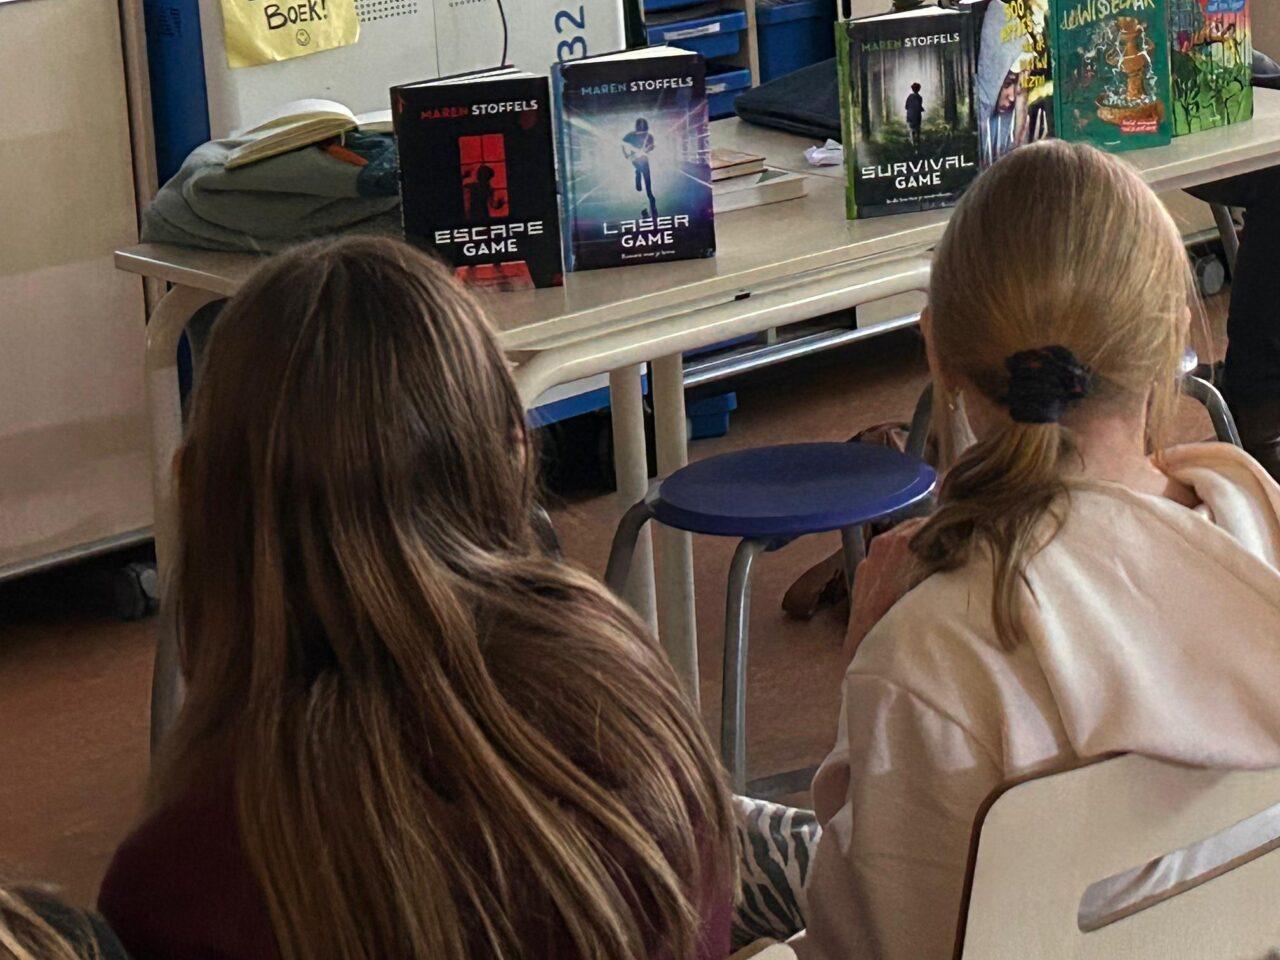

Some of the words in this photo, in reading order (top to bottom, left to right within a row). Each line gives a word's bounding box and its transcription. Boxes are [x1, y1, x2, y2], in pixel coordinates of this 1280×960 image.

[862, 40, 901, 52] MAREN
[904, 32, 960, 47] STOFFELS
[581, 83, 626, 96] MAREN
[630, 76, 693, 92] STOFFELS
[421, 102, 468, 119] MAREN
[472, 99, 538, 115] STOFFELS
[861, 155, 974, 179] SURVIVAL
[895, 172, 941, 189] GAME
[434, 221, 543, 244] ESCAPE
[603, 214, 690, 235] LASER
[463, 239, 518, 257] GAME
[621, 231, 674, 248] GAME
